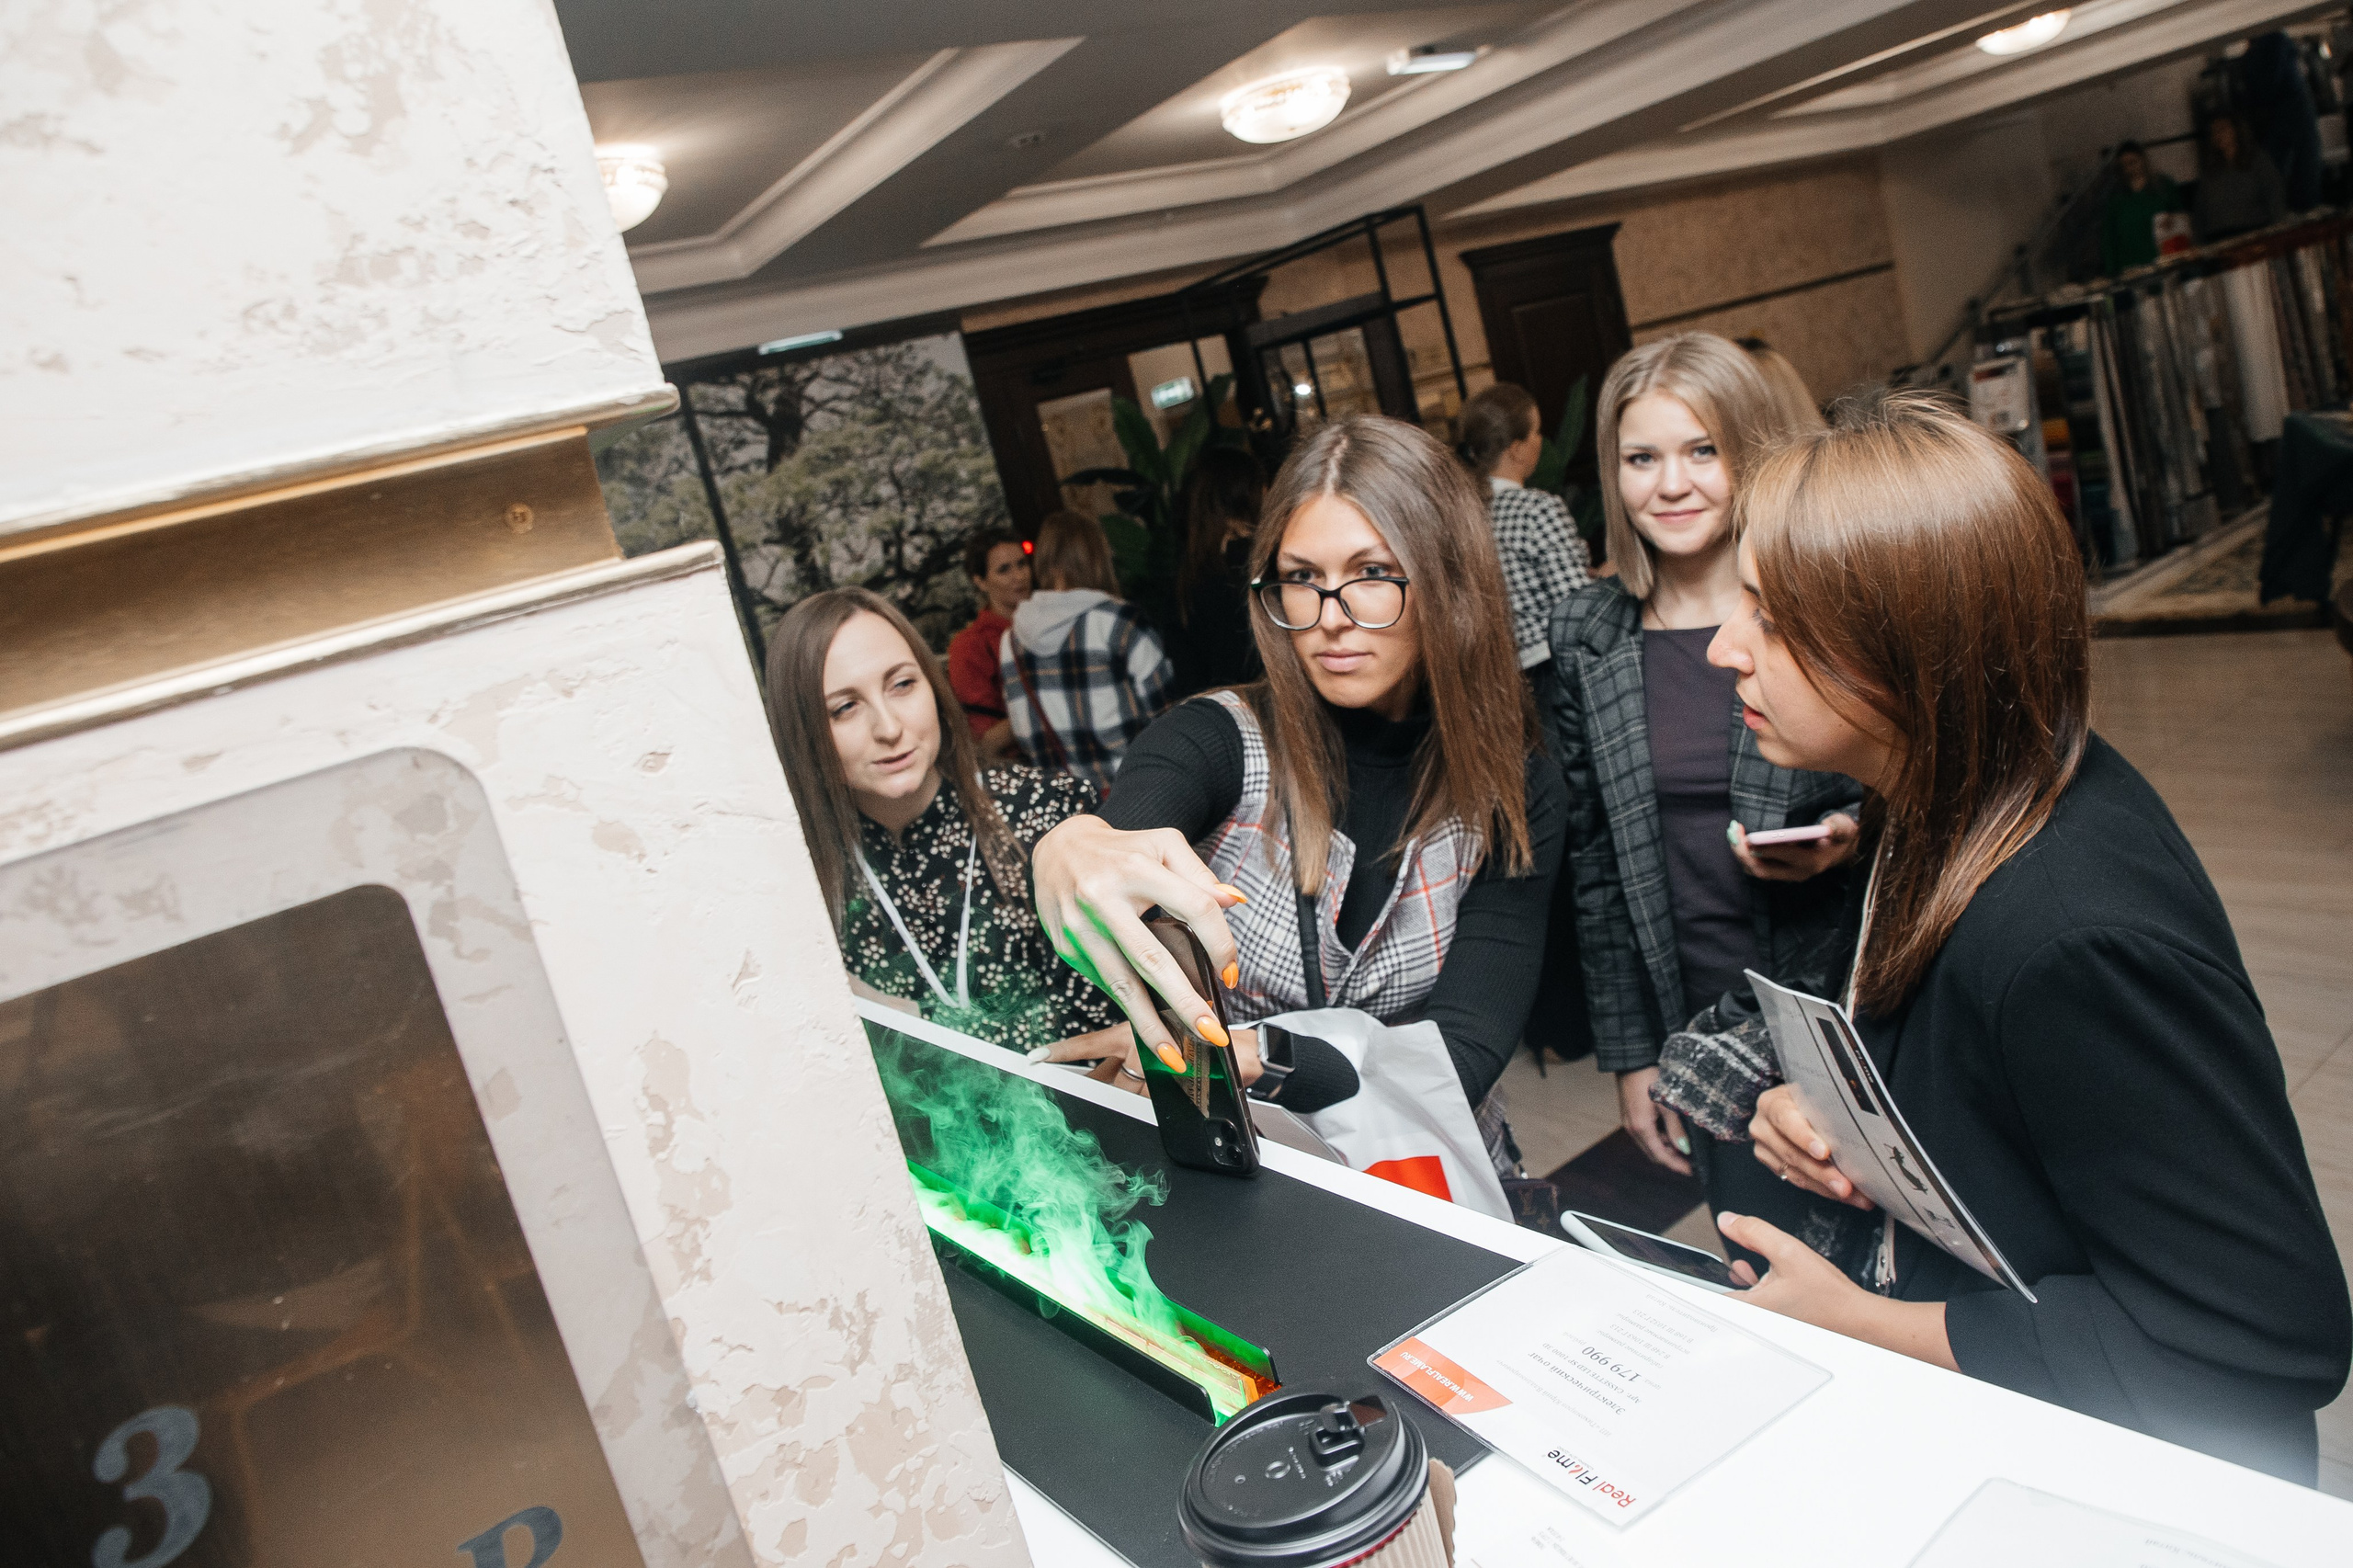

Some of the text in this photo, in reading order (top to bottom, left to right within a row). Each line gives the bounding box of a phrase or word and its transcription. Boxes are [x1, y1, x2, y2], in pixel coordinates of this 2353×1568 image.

[1644, 1292, 1667, 1308] Китай
[1541, 1341, 1554, 1350] 3D
[1643, 1327, 1691, 1355] встраиваемые
[1550, 1347, 1569, 1360] 1000
[1580, 1346, 1612, 1366] 990
[1623, 1344, 1665, 1369] габаритные
[1399, 1351, 1474, 1403] WWW.REALFLAME.RU
[1575, 1363, 1592, 1375] LED
[1608, 1362, 1642, 1382] 179
[1527, 1351, 1626, 1415] Электрический очаг
[1587, 1370, 1625, 1394] CASSETTE
[1540, 1389, 1563, 1405] Юрий
[1625, 1392, 1642, 1404] Арт.
[1591, 1480, 1637, 1508] Real
